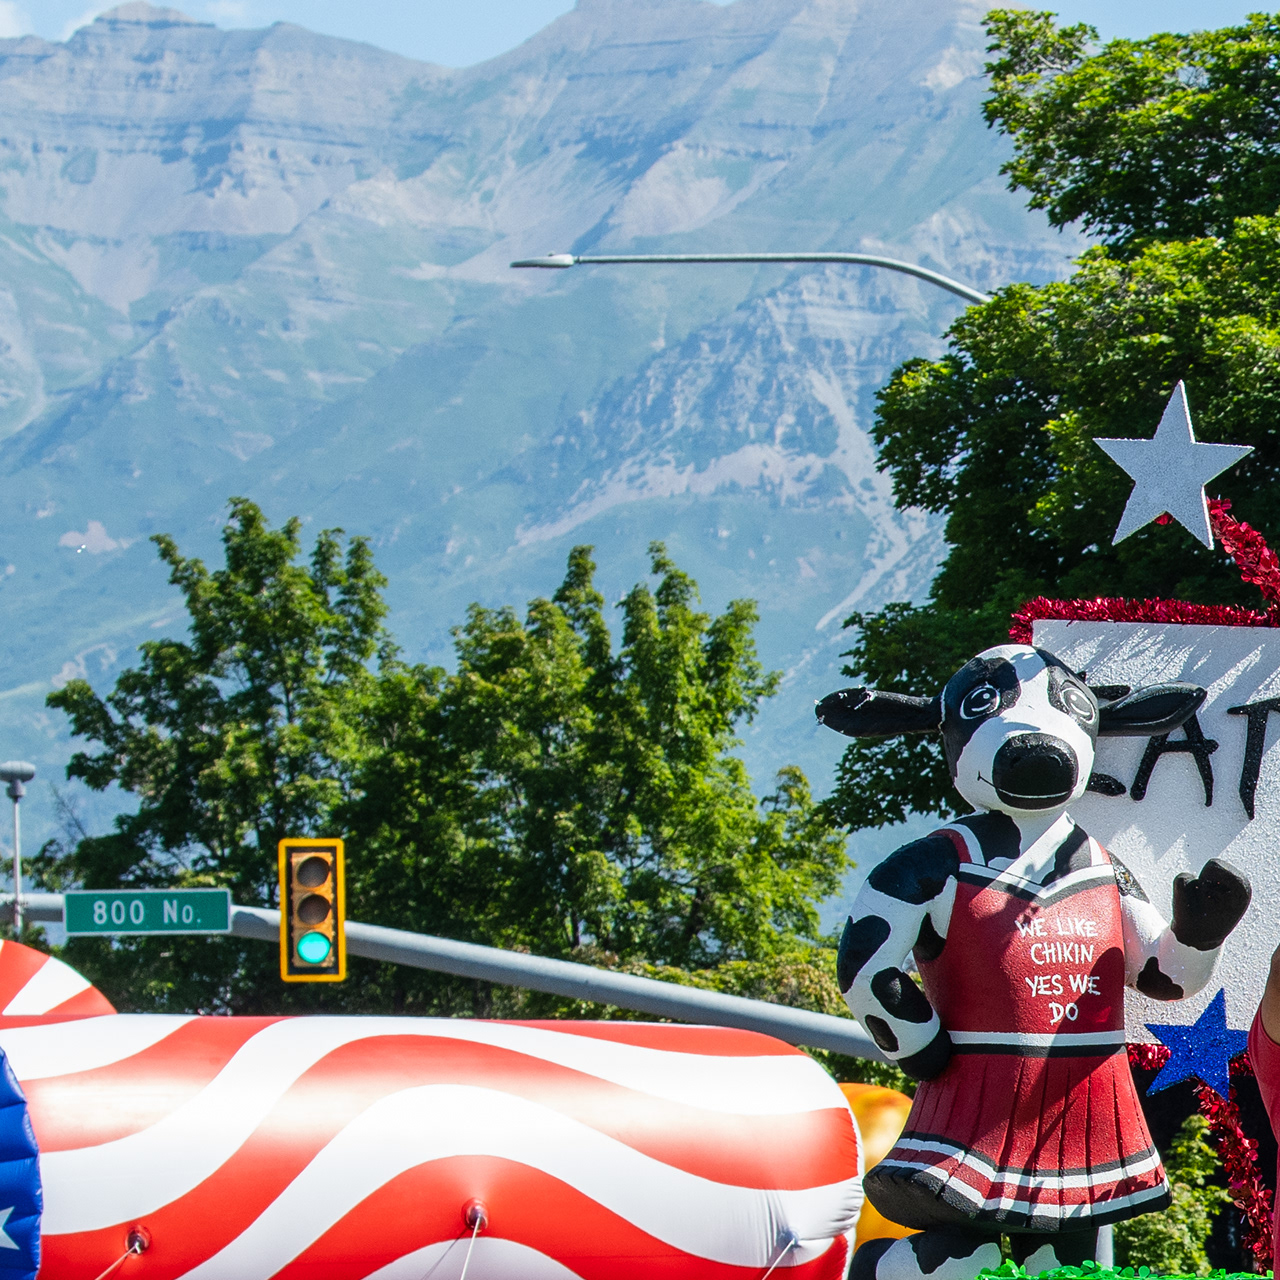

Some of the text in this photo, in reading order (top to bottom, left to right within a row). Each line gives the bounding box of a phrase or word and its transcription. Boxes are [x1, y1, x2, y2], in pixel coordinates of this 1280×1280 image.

[93, 899, 202, 925] 800 No.
[1015, 917, 1098, 937] WE LIKE
[1031, 942, 1094, 965] CHIKIN
[1025, 974, 1101, 997] YES WE
[1049, 1002, 1079, 1026] DO
